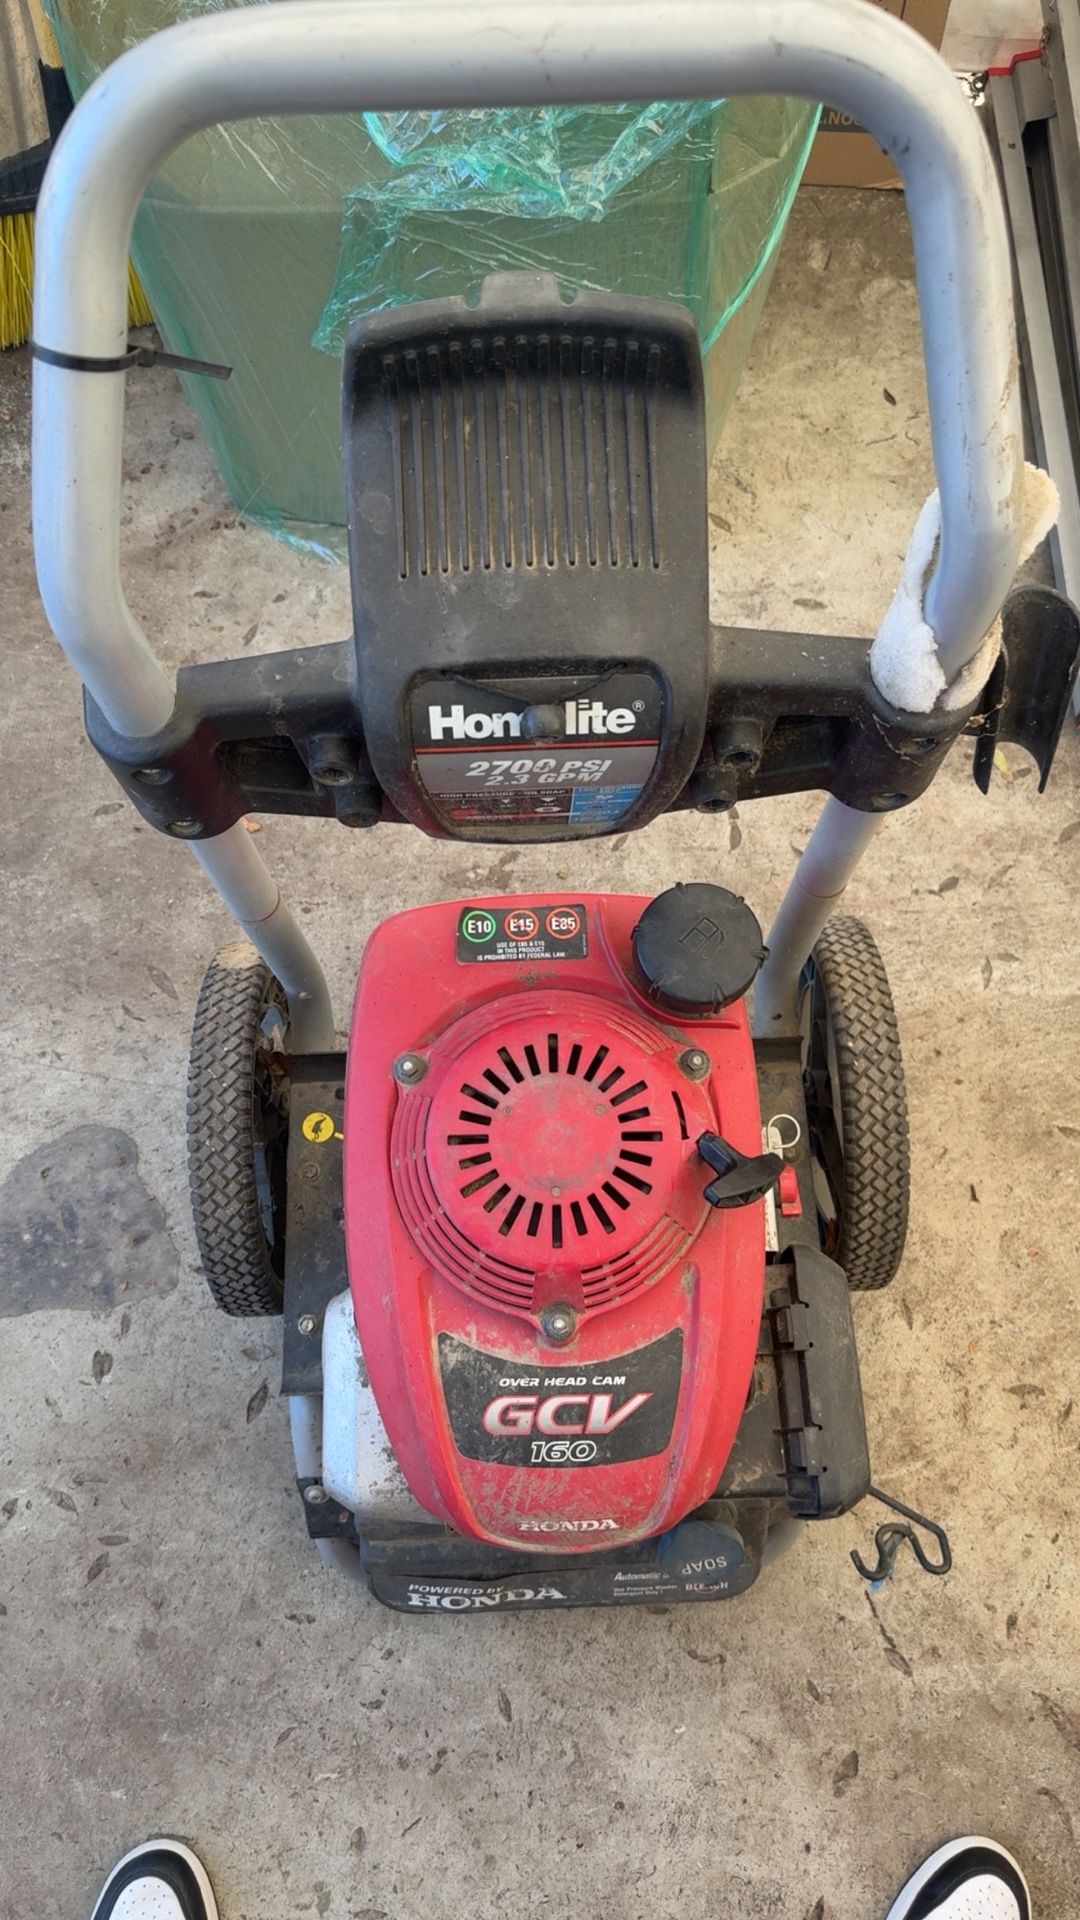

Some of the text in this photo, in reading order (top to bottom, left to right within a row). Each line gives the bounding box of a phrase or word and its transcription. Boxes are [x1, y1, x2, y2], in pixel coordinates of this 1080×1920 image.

[466, 758, 612, 777] 2700 PSI
[484, 771, 604, 786] 2.3 GPM
[467, 919, 492, 934] E10
[509, 917, 534, 932] E15
[551, 916, 576, 931] E85
[499, 1375, 627, 1387] OVER HEAD CAM
[482, 1392, 654, 1436] GCV
[531, 1440, 597, 1462] 160
[518, 1517, 621, 1532] HONDA
[681, 1556, 727, 1575] SOAP
[613, 1571, 661, 1581] Automatic
[408, 1584, 504, 1594] POWERED BY
[407, 1587, 568, 1610] HONDA
